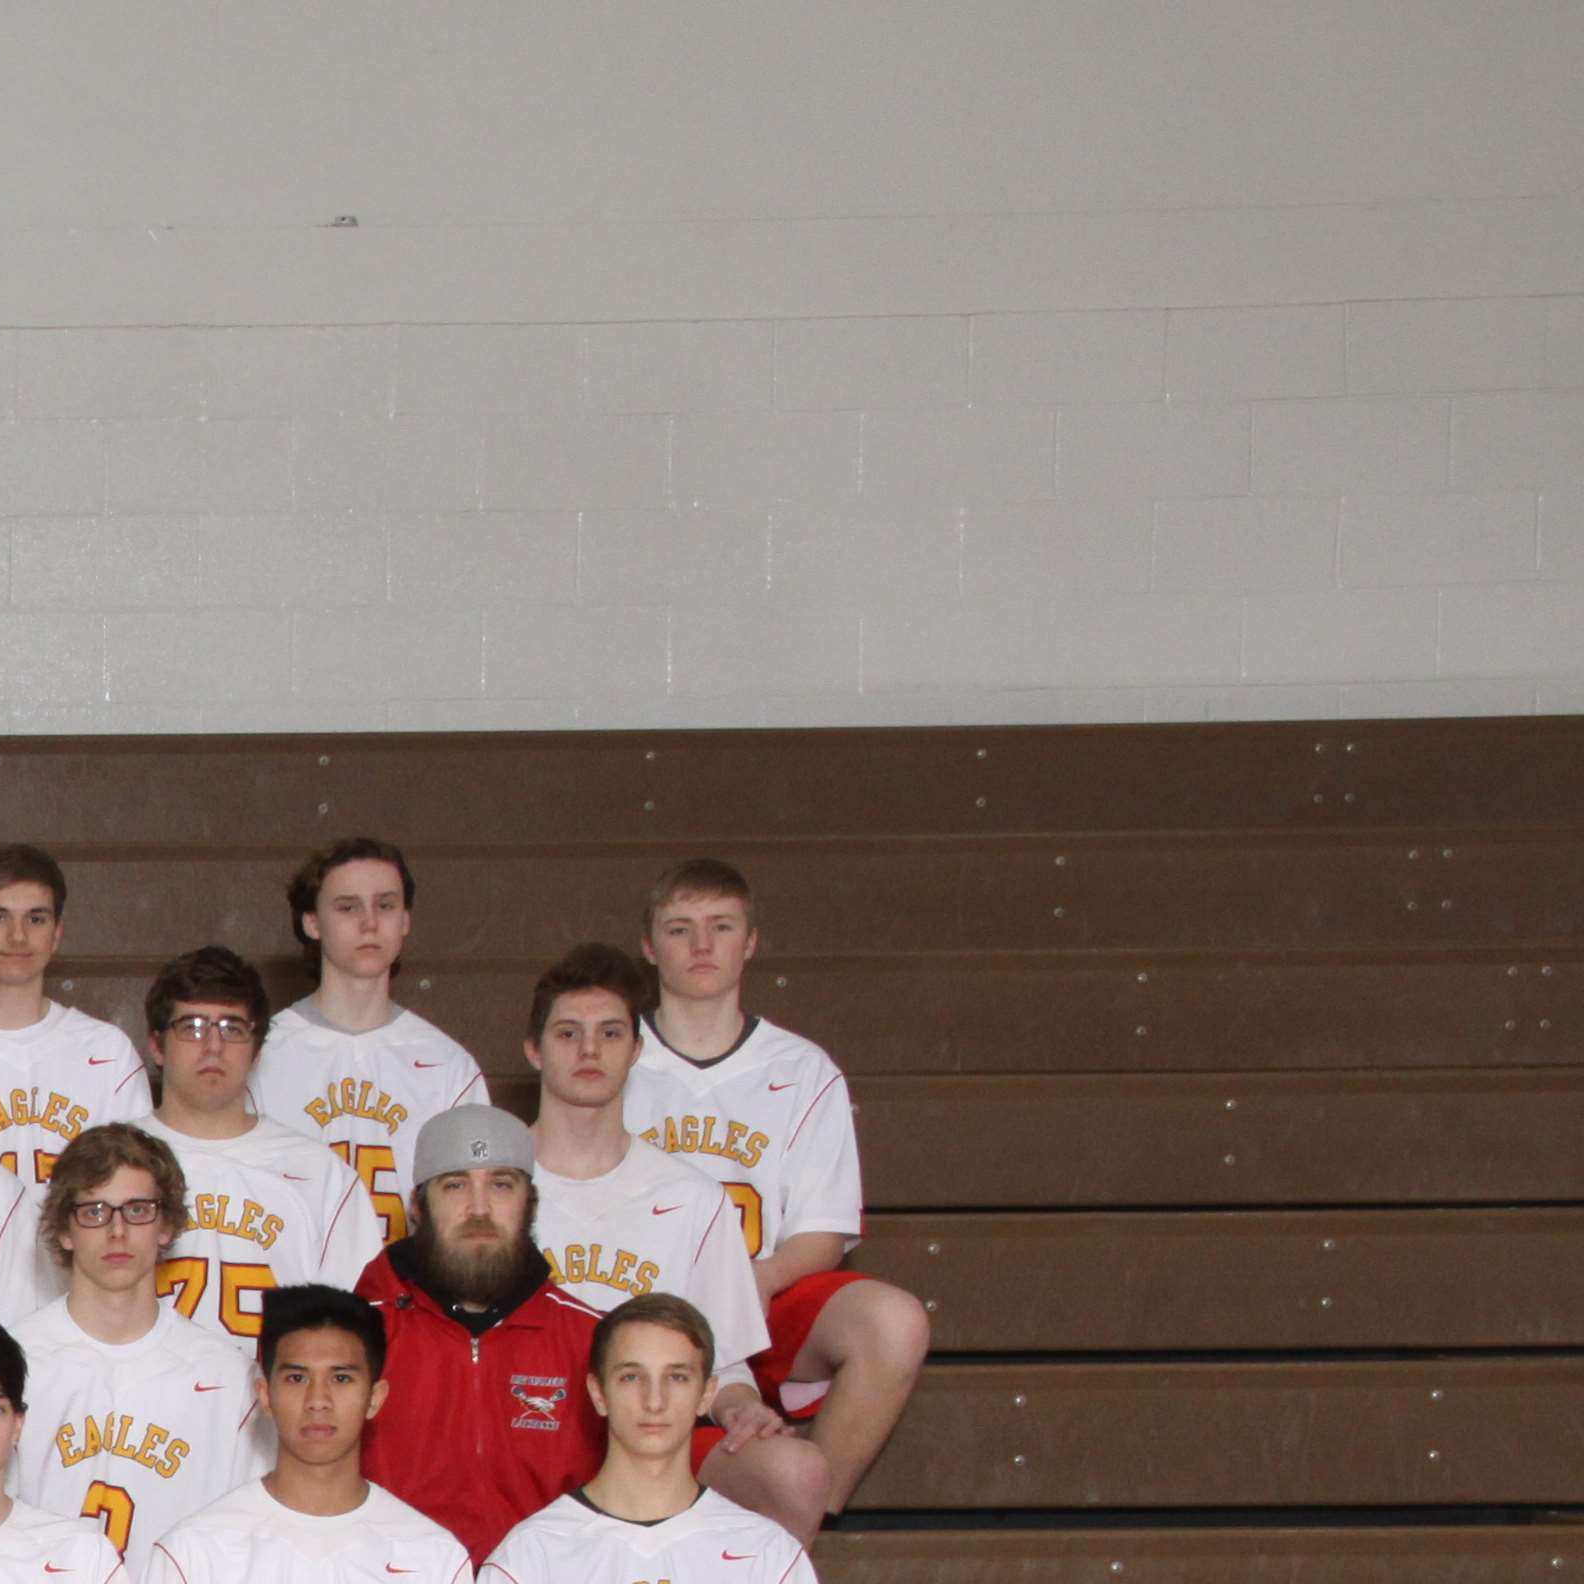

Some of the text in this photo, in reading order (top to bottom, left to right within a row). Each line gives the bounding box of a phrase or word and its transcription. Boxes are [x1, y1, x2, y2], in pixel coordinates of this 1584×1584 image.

[178, 1193, 284, 1251] GLES
[543, 1243, 660, 1297] AGLES
[55, 1411, 190, 1479] EAGLES
